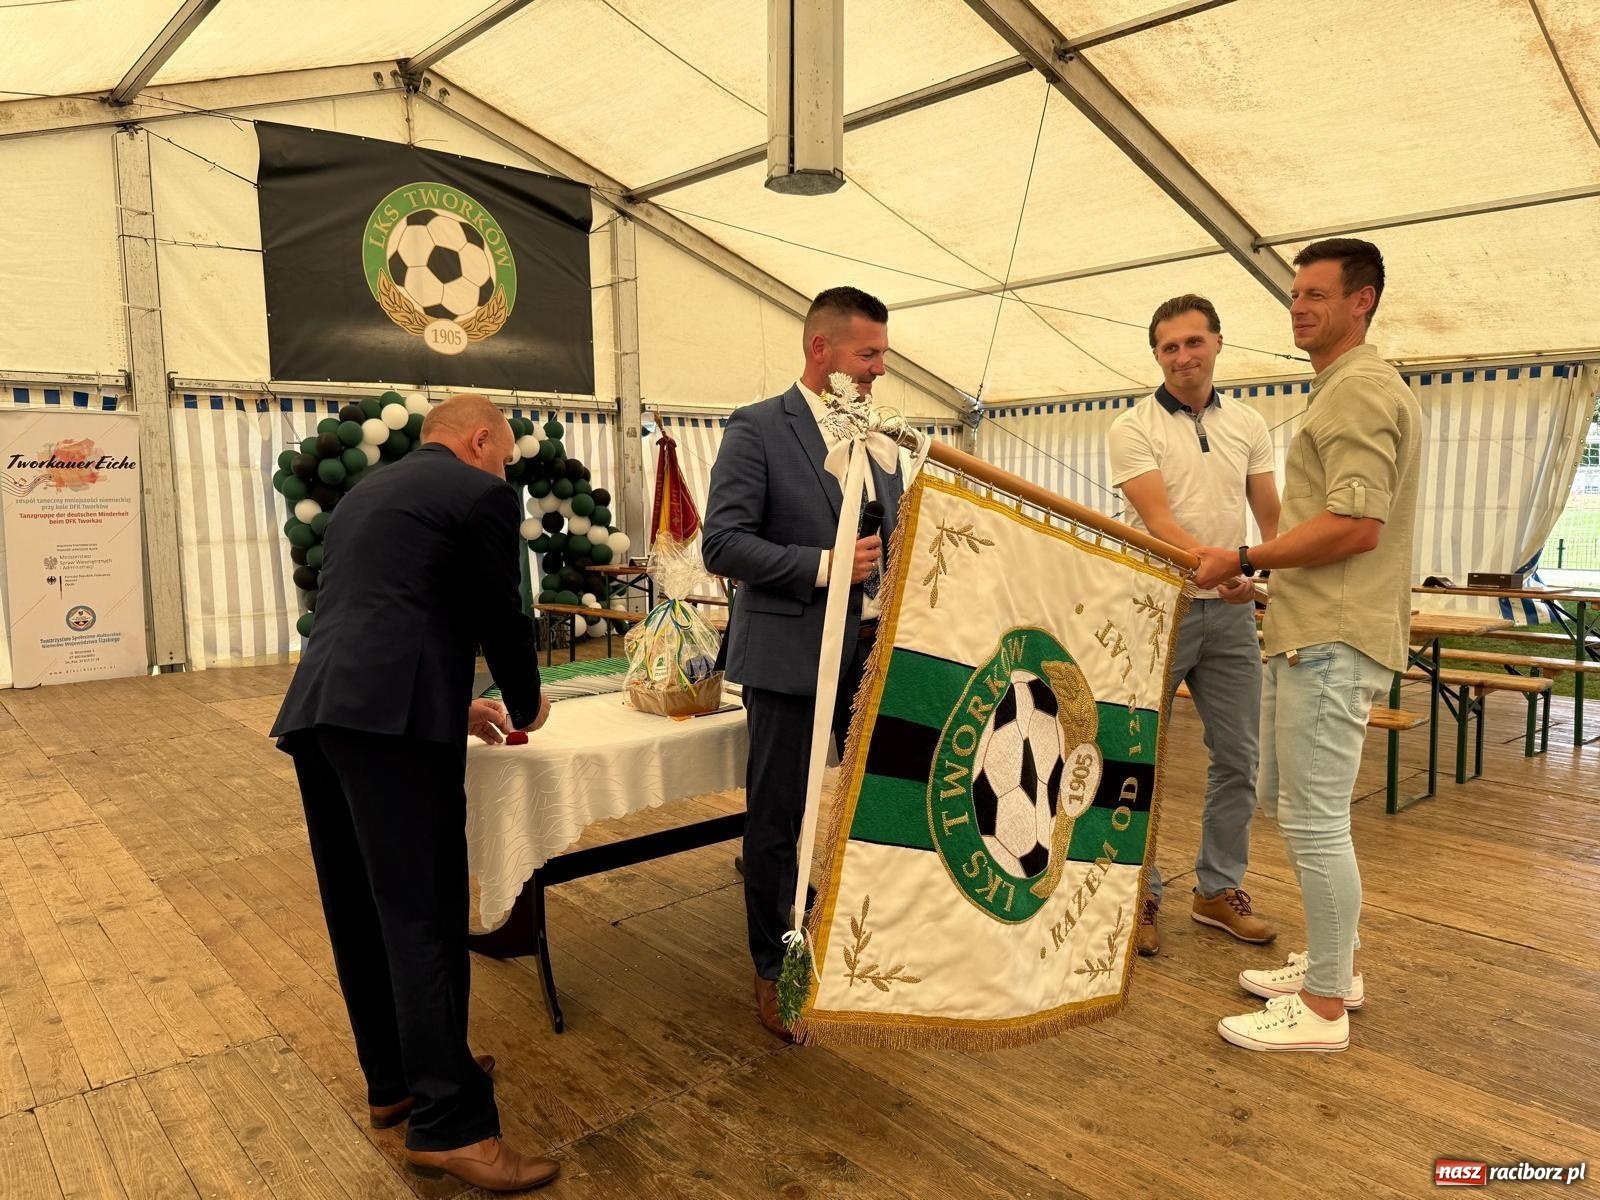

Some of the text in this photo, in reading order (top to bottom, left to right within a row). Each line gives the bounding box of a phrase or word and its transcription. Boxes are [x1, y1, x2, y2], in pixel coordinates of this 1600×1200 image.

[369, 188, 512, 267] LKS TWORKÓW
[431, 328, 462, 345] 1905
[7, 454, 136, 470] Tworkauer Eiche
[1068, 753, 1094, 805] 1905
[963, 849, 1016, 913] LKS
[1049, 840, 1119, 952] RAZEM
[1111, 776, 1139, 831] OD
